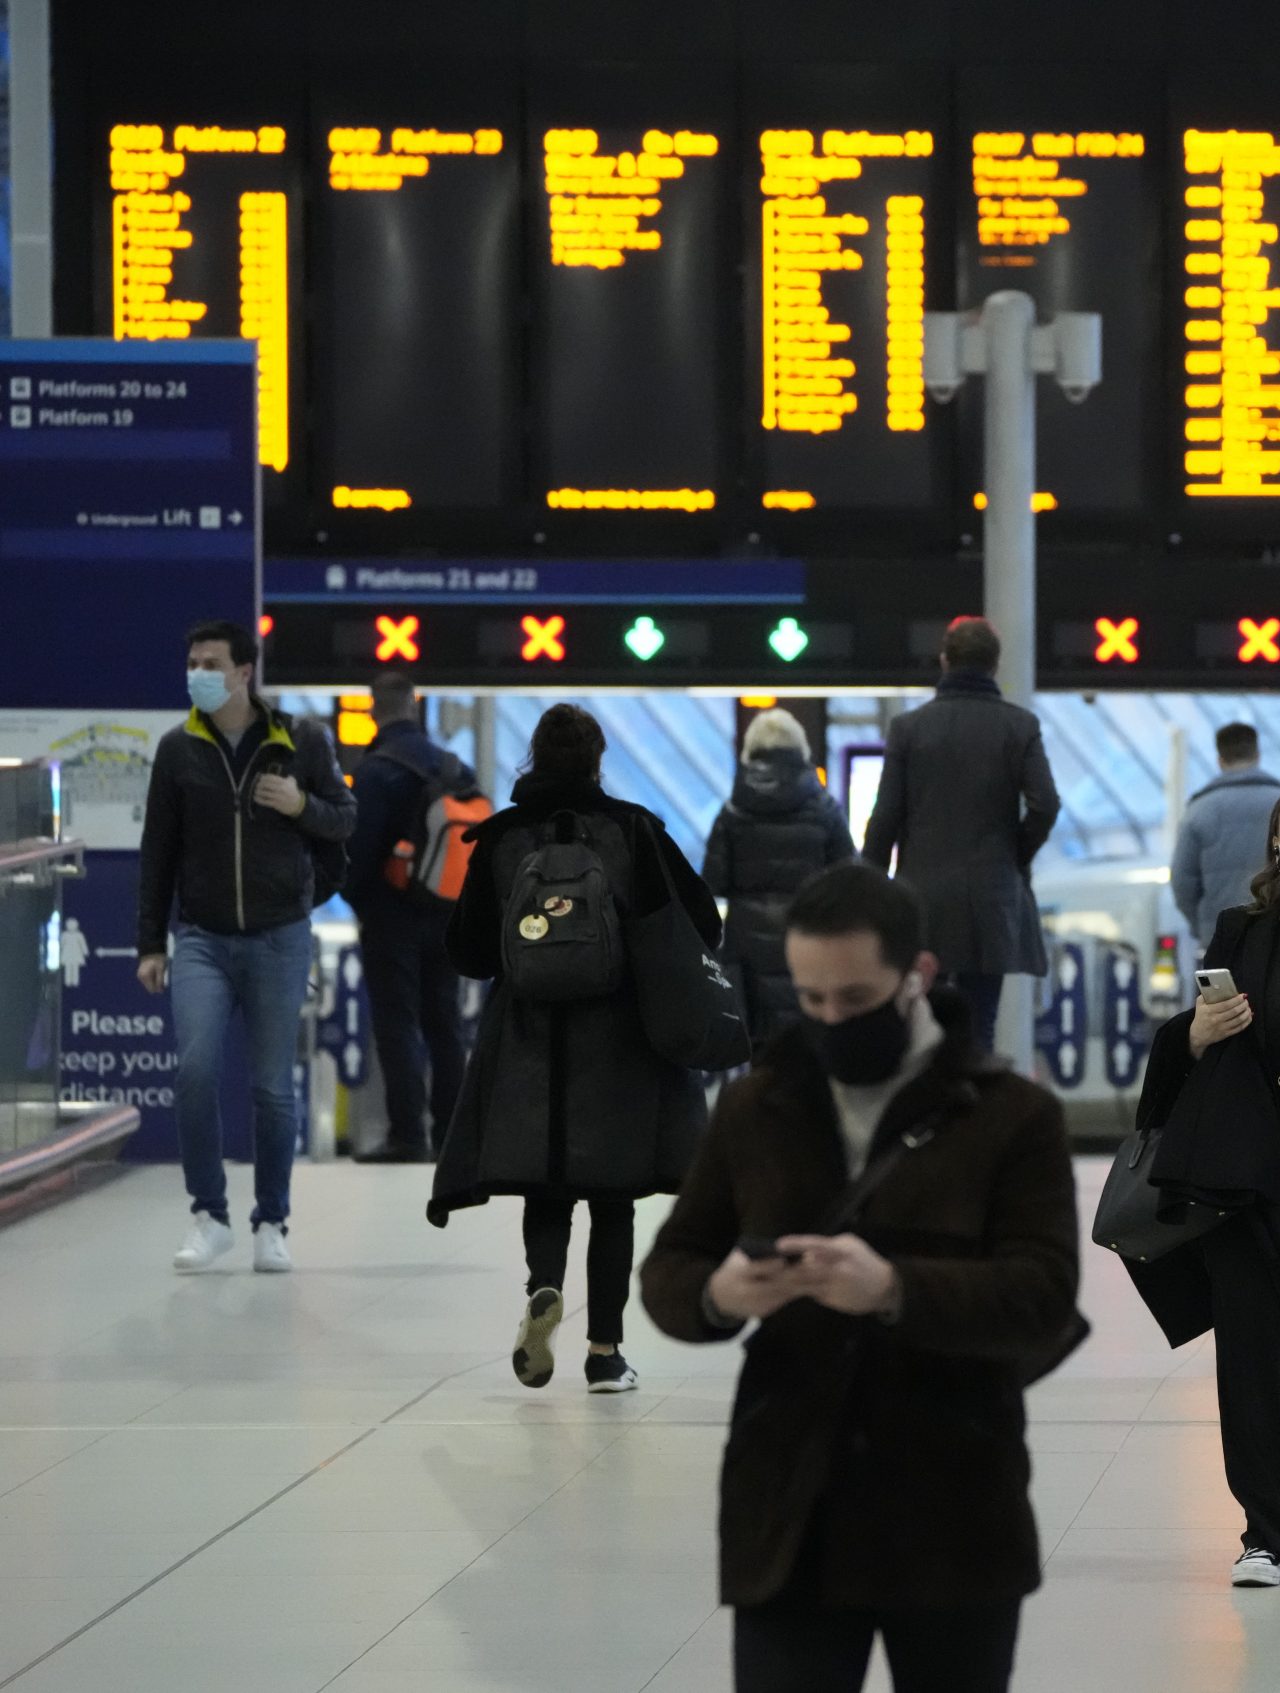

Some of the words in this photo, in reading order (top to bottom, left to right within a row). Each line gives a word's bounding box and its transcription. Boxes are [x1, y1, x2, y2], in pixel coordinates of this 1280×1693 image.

[38, 380, 117, 398] Platforms
[120, 380, 142, 398] 20
[144, 383, 163, 398] to
[165, 381, 188, 399] 24
[38, 408, 109, 426] Platform
[113, 408, 134, 427] 19
[163, 509, 192, 526] Lift
[356, 567, 444, 590] Platforms
[448, 567, 471, 590] 21
[474, 569, 510, 590] and
[513, 568, 538, 590] 22
[71, 1009, 164, 1035] Please
[59, 1081, 174, 1107] distance
